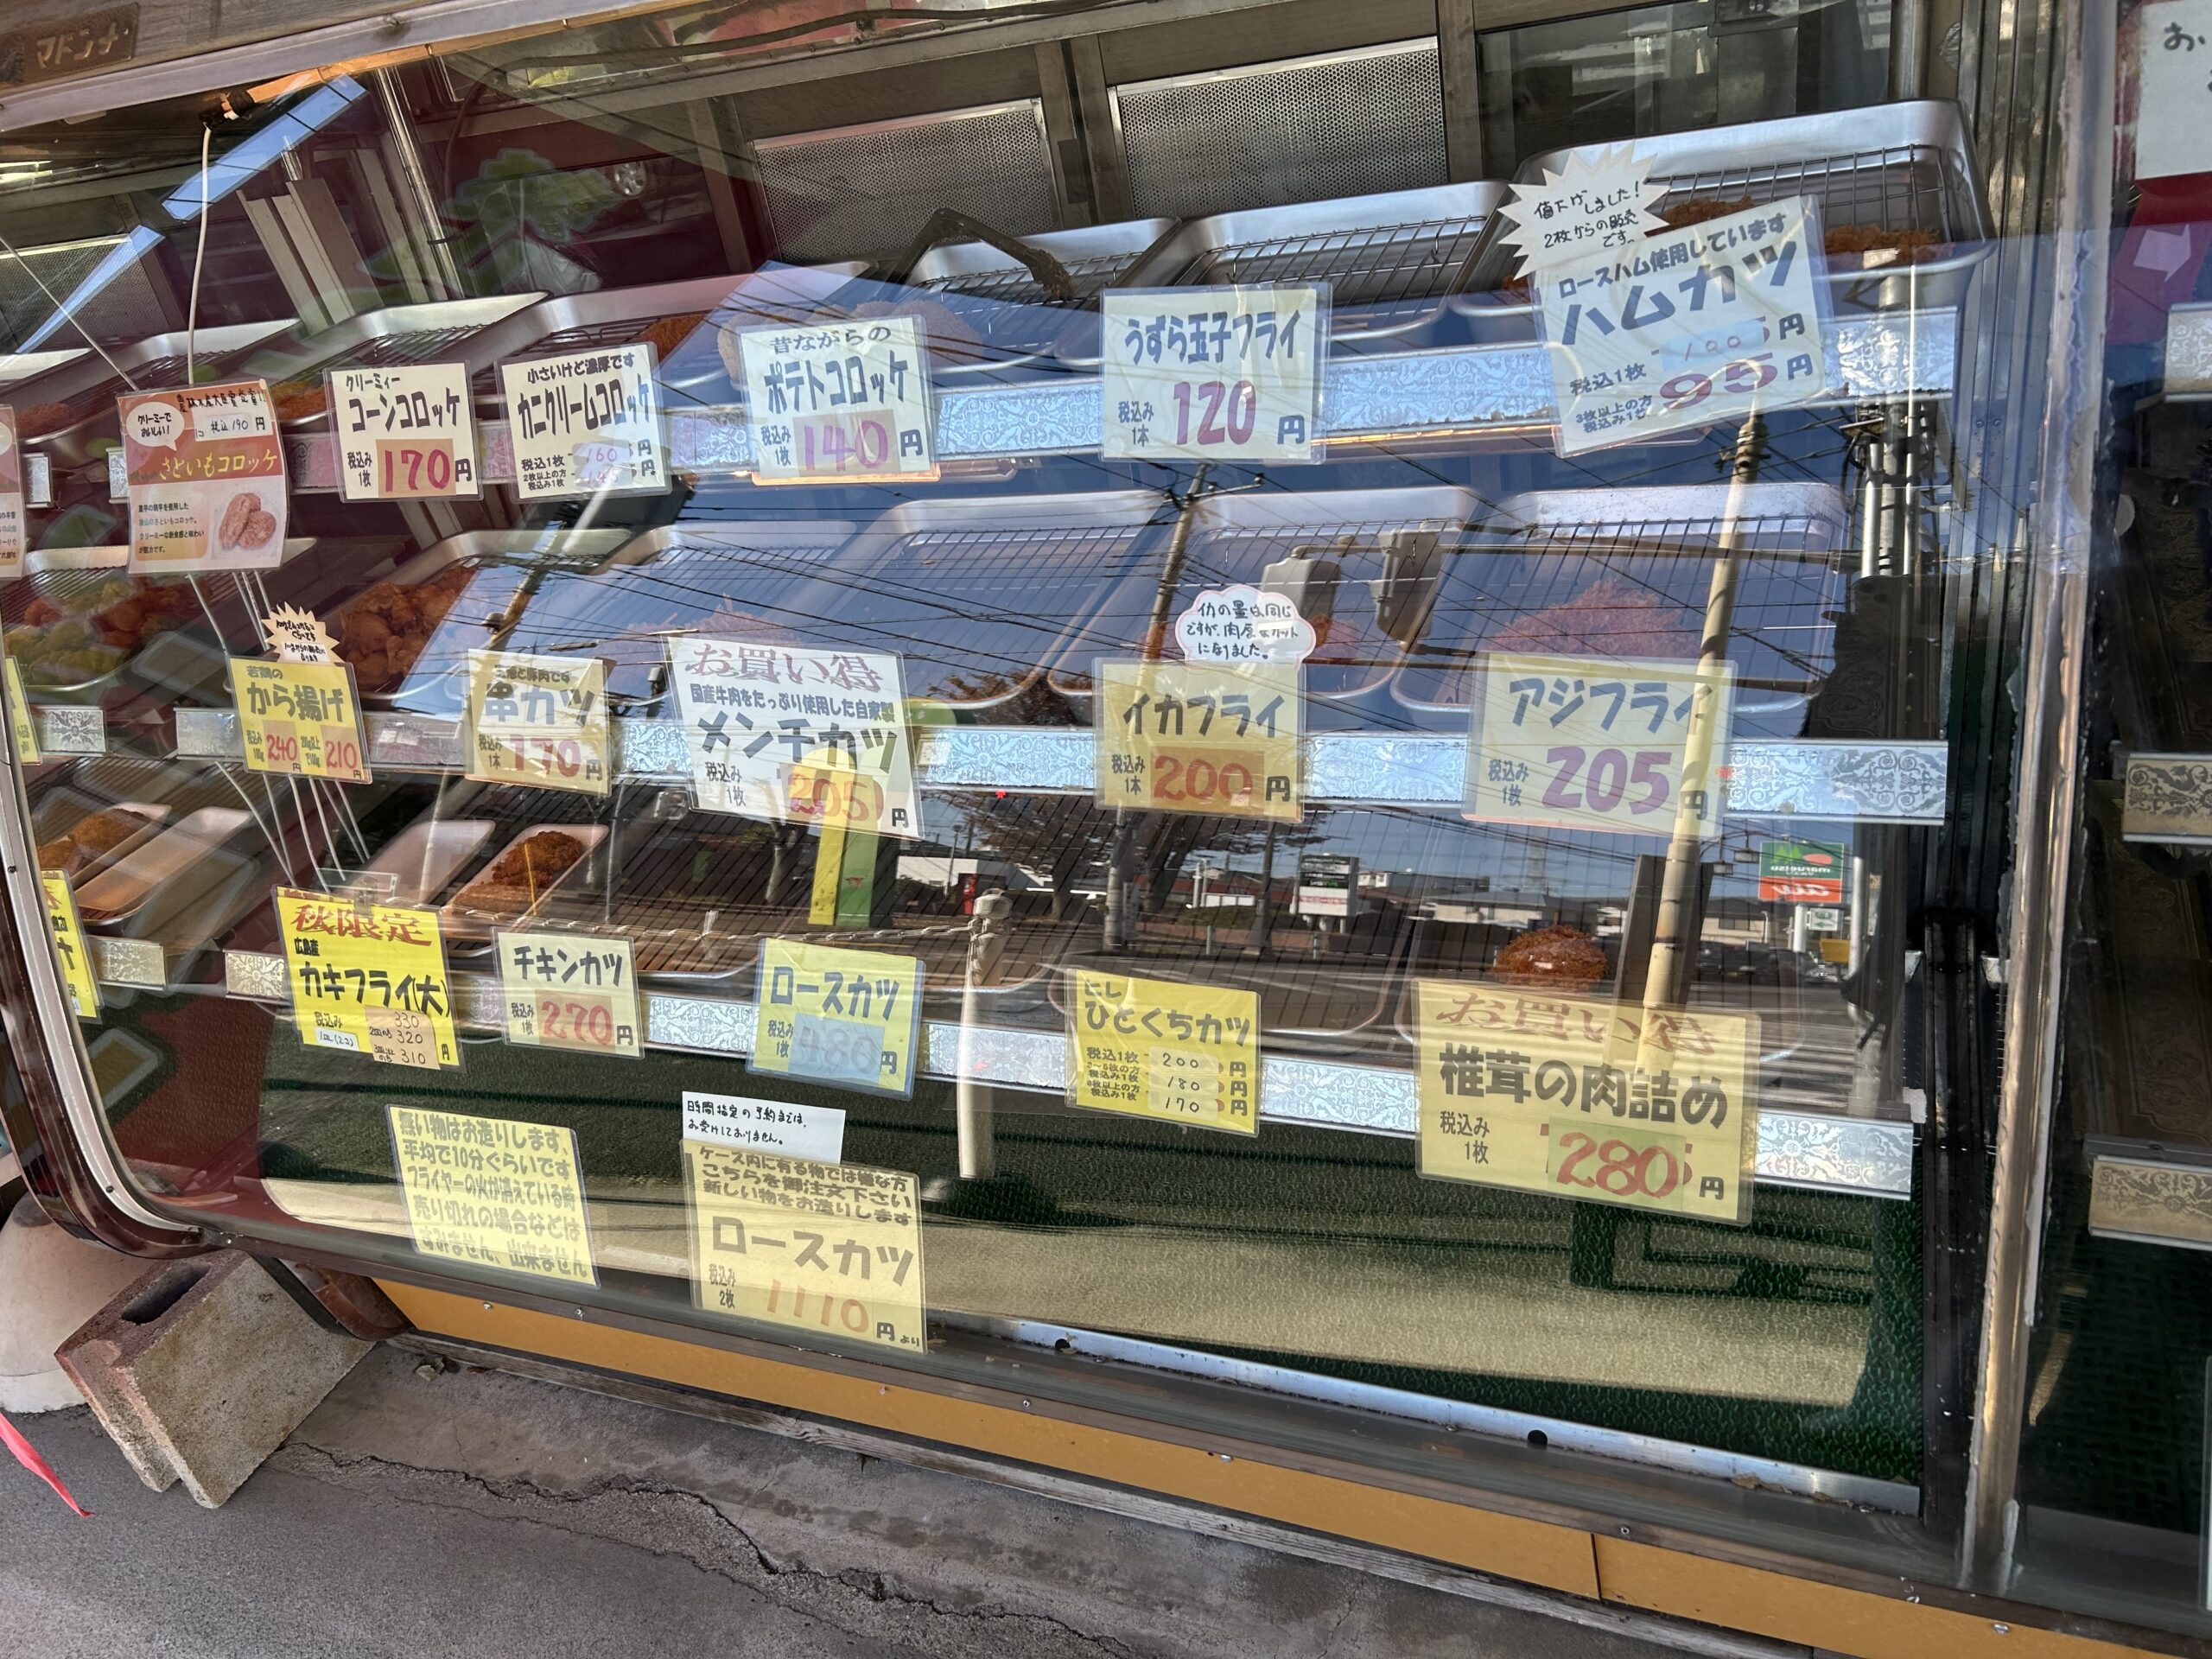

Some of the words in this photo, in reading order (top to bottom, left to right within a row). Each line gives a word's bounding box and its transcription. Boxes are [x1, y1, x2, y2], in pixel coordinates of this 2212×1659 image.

[1559, 213, 1787, 298] ロースハム使用しています
[1561, 241, 1796, 345] ハムカツ
[1779, 313, 1805, 340] 円
[770, 327, 891, 355] 昔ながらの
[527, 353, 635, 384] 小さいけど濃厚です
[764, 349, 909, 415] ポテトコロッケ
[1570, 363, 1647, 397] 税込1枚
[1659, 353, 1778, 410] 95
[1788, 353, 1813, 379] 円
[349, 386, 461, 432] コーンコロッケ
[518, 373, 650, 440] カニクリームコロッケ
[1118, 400, 1154, 423] 税込み
[1173, 380, 1256, 445] 120
[1277, 415, 1306, 444] 円
[232, 418, 249, 430] 190
[255, 416, 266, 430] 円
[760, 425, 791, 445] 税込み
[1132, 425, 1149, 447] 1本
[521, 454, 565, 472] 税込1枚
[638, 439, 652, 457] 円
[776, 447, 791, 466] 1枚
[804, 419, 888, 472] 140
[900, 429, 924, 457] 円
[159, 449, 278, 480] さといもコロッケ
[347, 452, 372, 469] 税込み
[385, 448, 451, 493] 170
[454, 459, 472, 483] 円
[641, 459, 656, 476] 円
[359, 471, 372, 487] 1枚
[1198, 643, 1268, 660] になりました。
[684, 644, 883, 693] お買い得
[246, 682, 344, 722] から揚げ
[485, 681, 595, 728] 串カツ
[690, 683, 895, 722] 国産牛肉をたっぷり使用した自家製
[1123, 693, 1285, 738] イカフライ
[266, 734, 297, 760] 240
[326, 740, 357, 769] 210
[479, 734, 503, 751] 税込み
[697, 710, 897, 774] メンチカツ
[489, 753, 501, 769] 1本
[510, 734, 581, 777] 170
[586, 760, 602, 780] 円
[1112, 754, 1145, 774] 税込み
[1488, 759, 1529, 783] 税込み
[705, 762, 742, 783] 税込み
[1125, 777, 1141, 796] 1本
[1154, 755, 1253, 801] 200
[1266, 776, 1290, 802] 円
[1541, 747, 1671, 815] 205
[1676, 791, 1707, 820] 円
[728, 786, 746, 806] 1枚
[1502, 785, 1522, 806] 1枚
[892, 808, 907, 827] 円
[291, 904, 432, 947] 秋限定
[294, 937, 320, 957] 広島産
[513, 945, 623, 987] チキンカツ
[770, 966, 899, 1021] ロースカツ
[315, 1011, 343, 1028] 税込み
[394, 1012, 419, 1029] 330
[511, 1002, 534, 1018] 税込み
[542, 1001, 613, 1046] 270
[617, 1025, 634, 1046] 円
[1084, 1001, 1250, 1047] ひとくちカツ
[1435, 992, 1722, 1056] お買い得
[397, 1030, 423, 1044] 320
[522, 1020, 533, 1035] 1枚
[767, 1020, 793, 1038] 税込み
[401, 1049, 426, 1065] 310
[777, 1042, 790, 1058] 1枚
[880, 1051, 898, 1075] 円
[1087, 1047, 1139, 1064] 税込1枚
[1162, 1052, 1198, 1068] 200
[1230, 1061, 1247, 1077] 円
[1167, 1077, 1200, 1090] 180
[1230, 1080, 1247, 1096] 円
[1439, 1043, 1727, 1129] 椎茸の肉詰め
[1166, 1097, 1199, 1112] 170
[1230, 1099, 1247, 1116] 円
[1440, 1110, 1490, 1138] 税込み
[1465, 1141, 1489, 1164] 1枚
[1556, 1131, 1679, 1199] 280
[1699, 1176, 1724, 1200] 円
[702, 1163, 911, 1208] こちらを御注文下さい
[703, 1179, 912, 1226] 新しい物をお造りします
[413, 1194, 581, 1242] 売り切れの場合などは
[712, 1216, 913, 1286] ロースカツ
[709, 1263, 735, 1287] 税込み
[720, 1289, 734, 1308] 2枚
[766, 1279, 869, 1333] 1110
